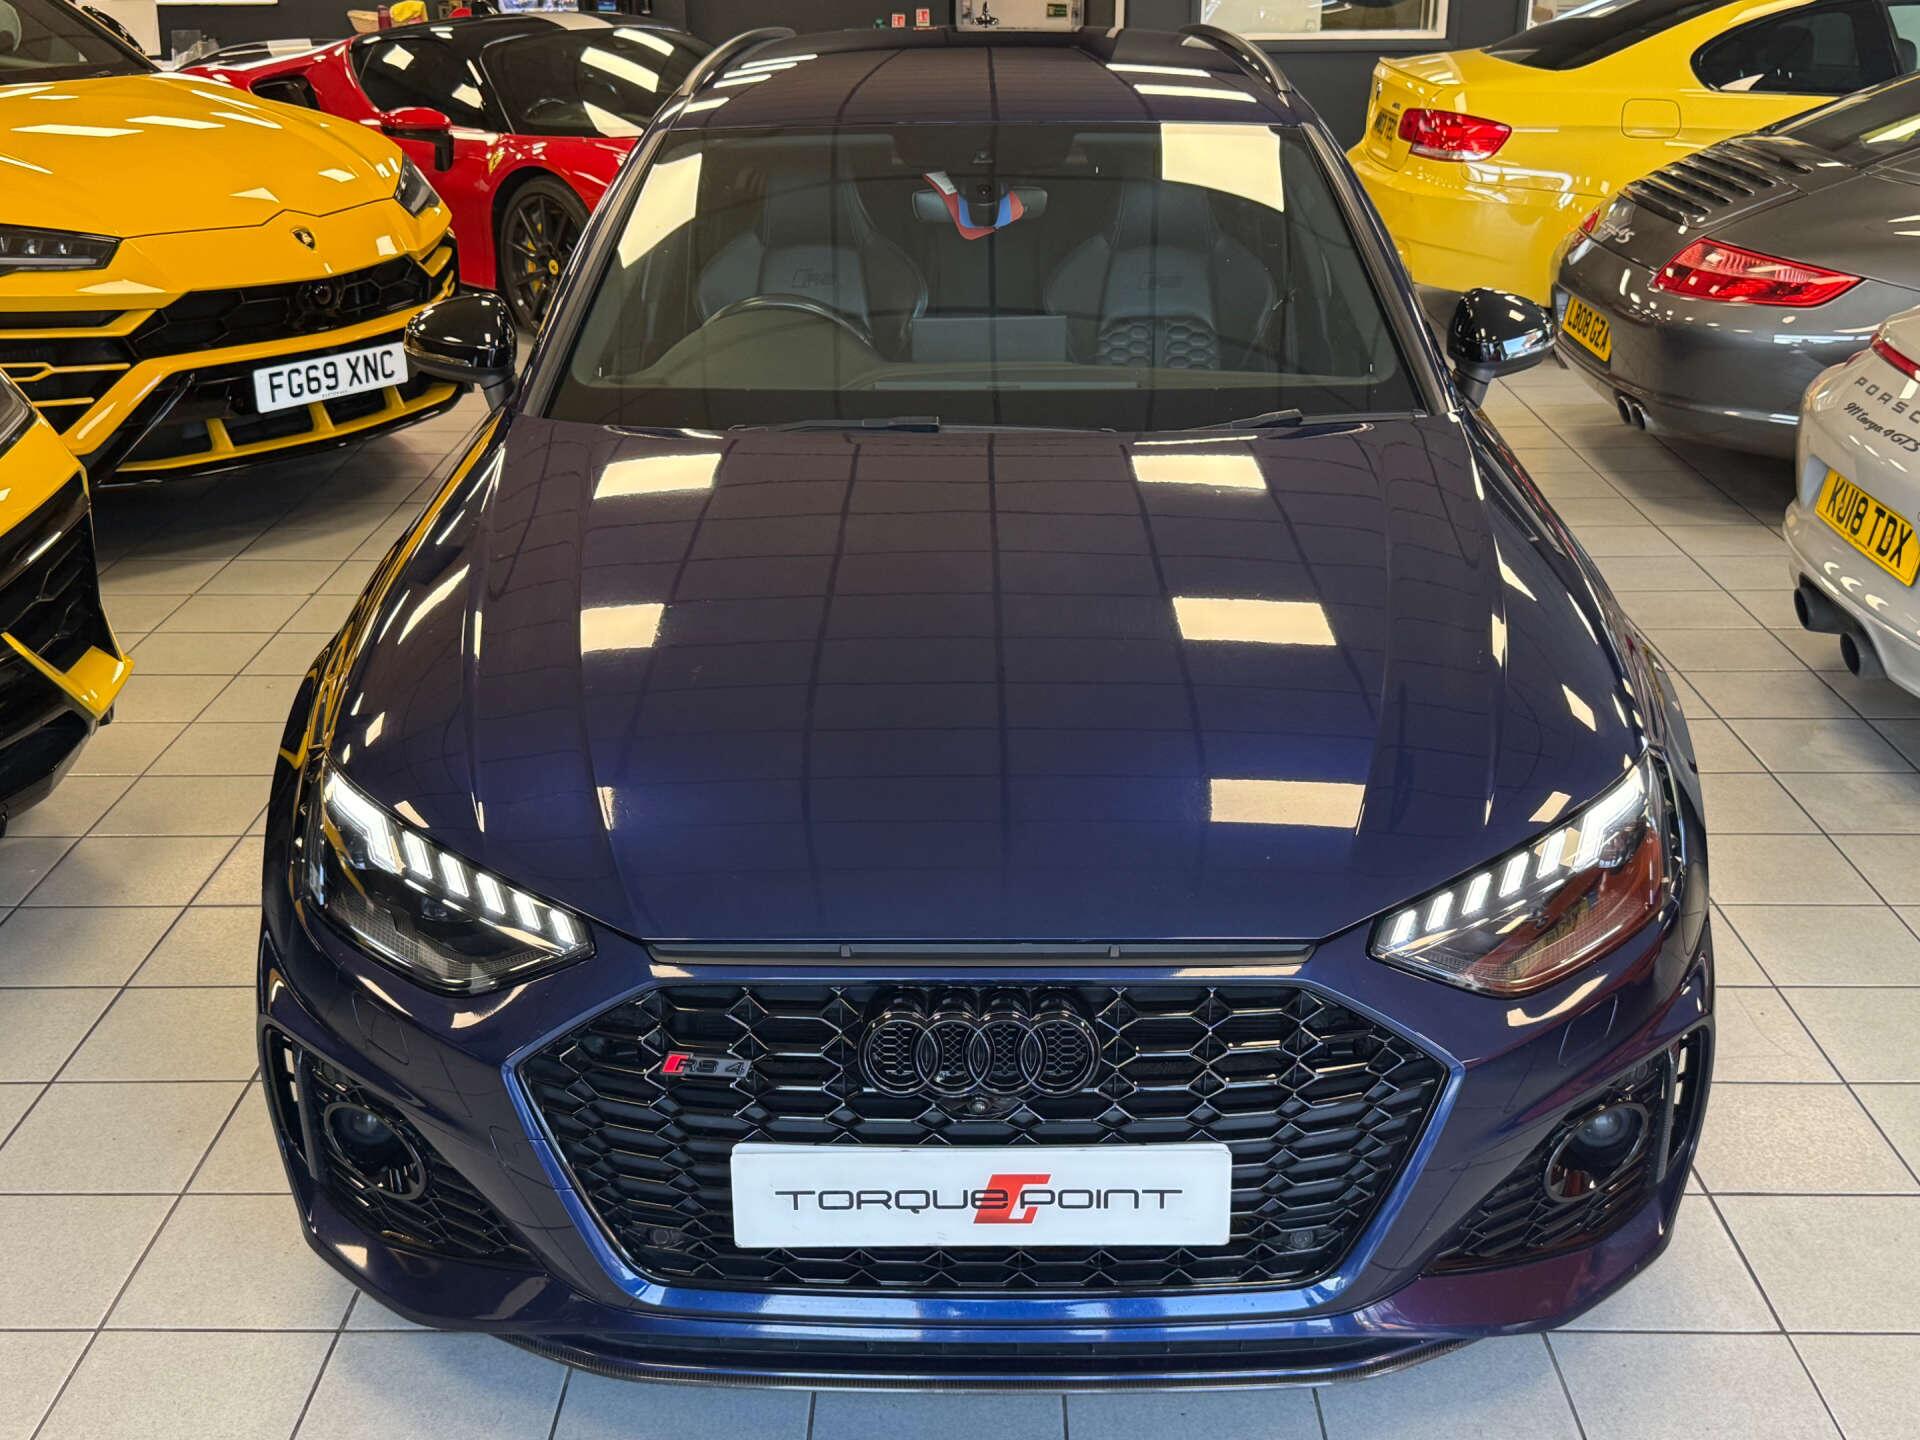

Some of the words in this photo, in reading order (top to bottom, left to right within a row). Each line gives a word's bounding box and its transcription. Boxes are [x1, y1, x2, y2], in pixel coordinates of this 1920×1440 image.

[268, 361, 339, 403] FG69
[346, 350, 395, 387] XNC
[1826, 476, 1869, 535] KU18
[1867, 506, 1913, 568] TDX
[775, 1190, 1008, 1214] TORQUE
[1020, 1189, 1183, 1210] POINT
